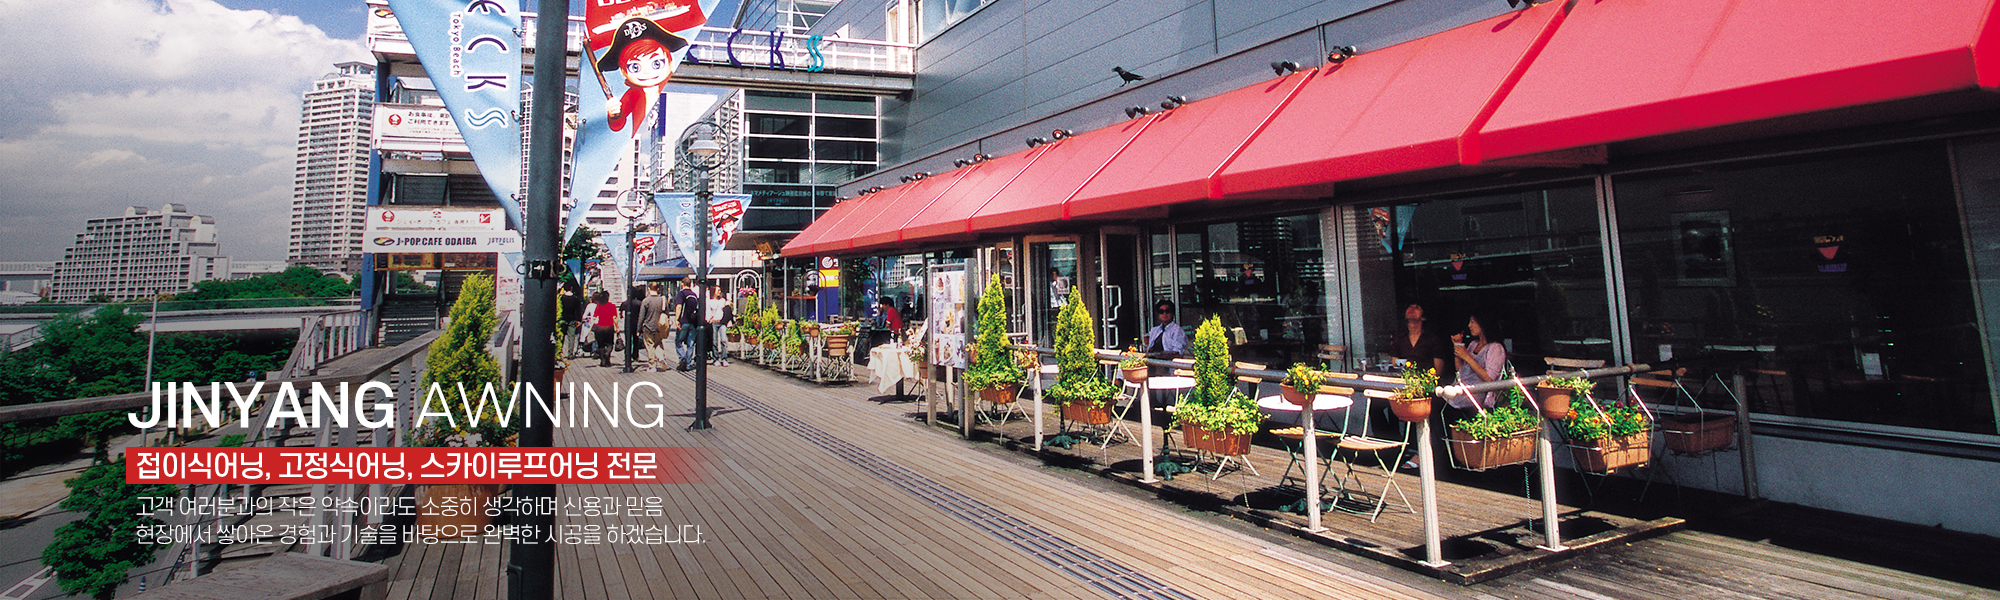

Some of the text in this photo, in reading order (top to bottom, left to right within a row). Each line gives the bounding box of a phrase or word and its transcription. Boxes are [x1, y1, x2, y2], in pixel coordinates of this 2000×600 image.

[452, 13, 461, 75] Tokyo Beach
[445, 237, 477, 246] ODAIBA
